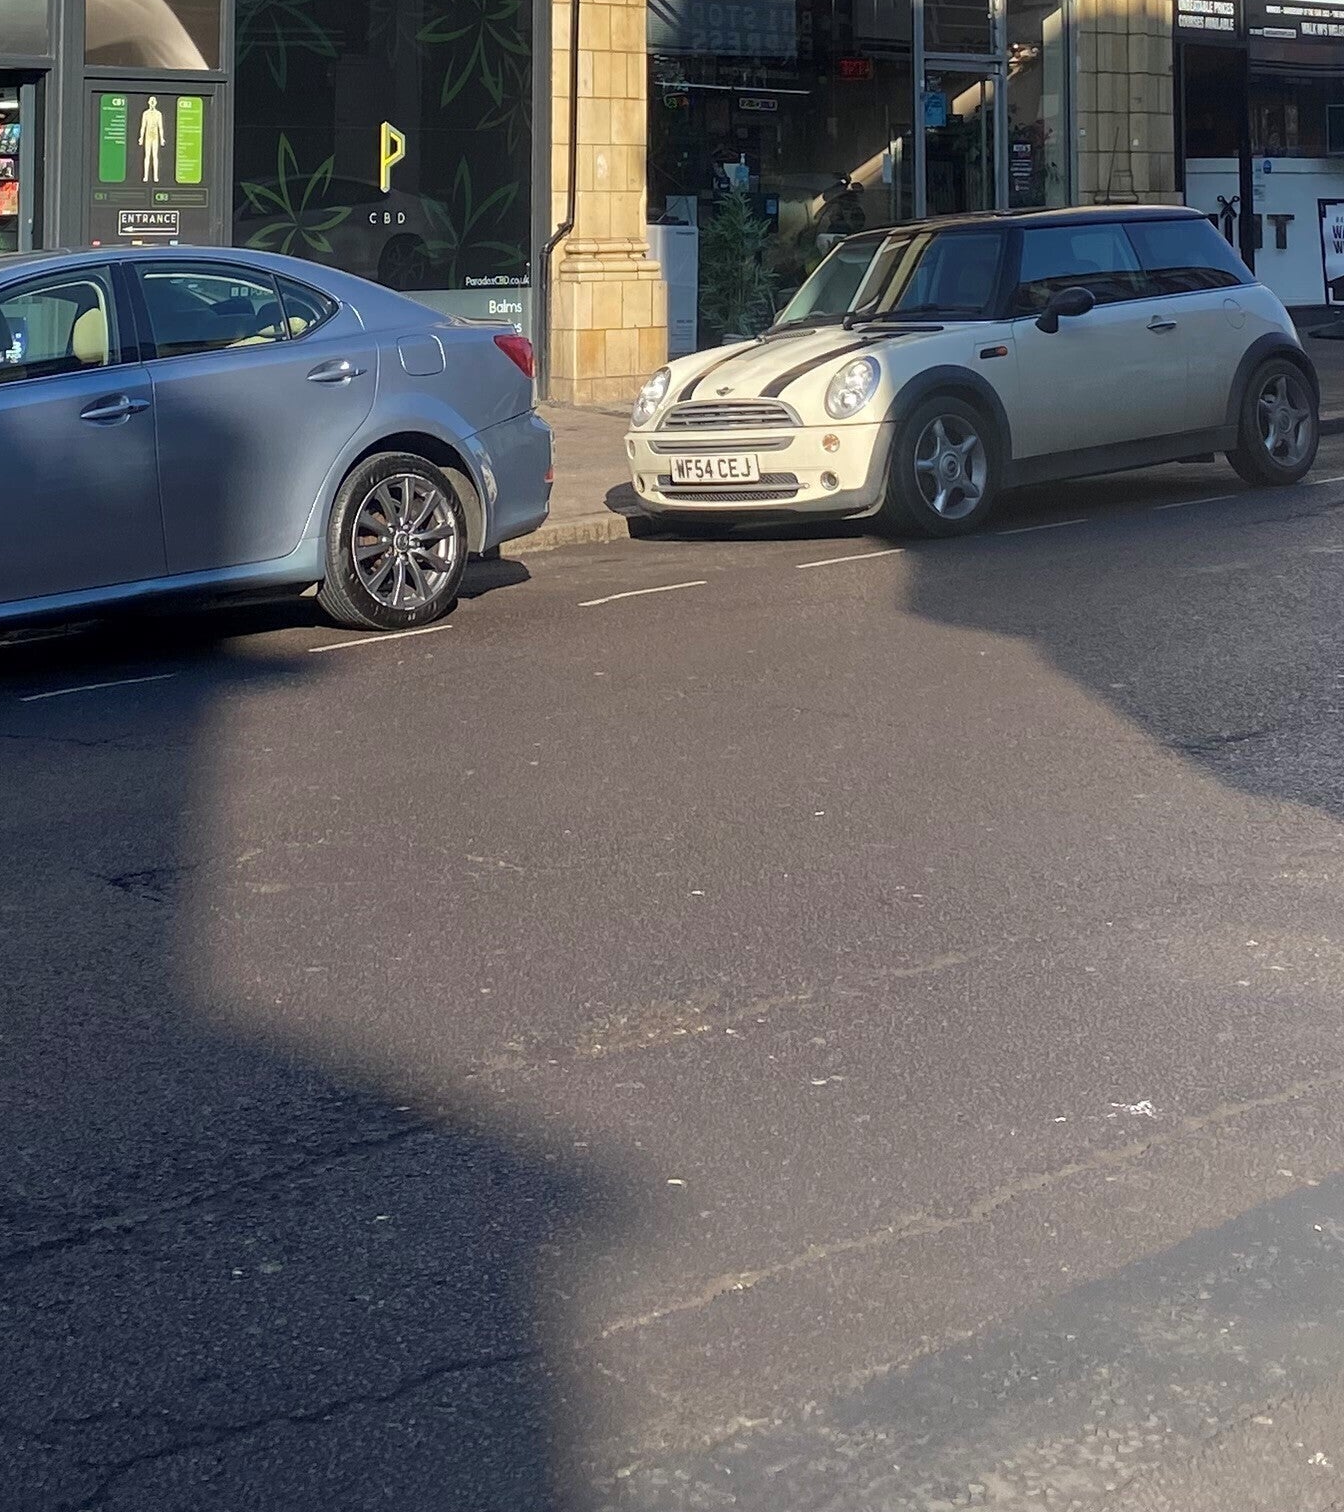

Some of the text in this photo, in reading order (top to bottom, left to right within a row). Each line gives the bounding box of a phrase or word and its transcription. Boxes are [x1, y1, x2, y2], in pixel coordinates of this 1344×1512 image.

[121, 214, 177, 224] ENTRANCE
[369, 212, 406, 225] CBD
[488, 300, 523, 314] Balms
[675, 456, 752, 480] WF54 CEJ
